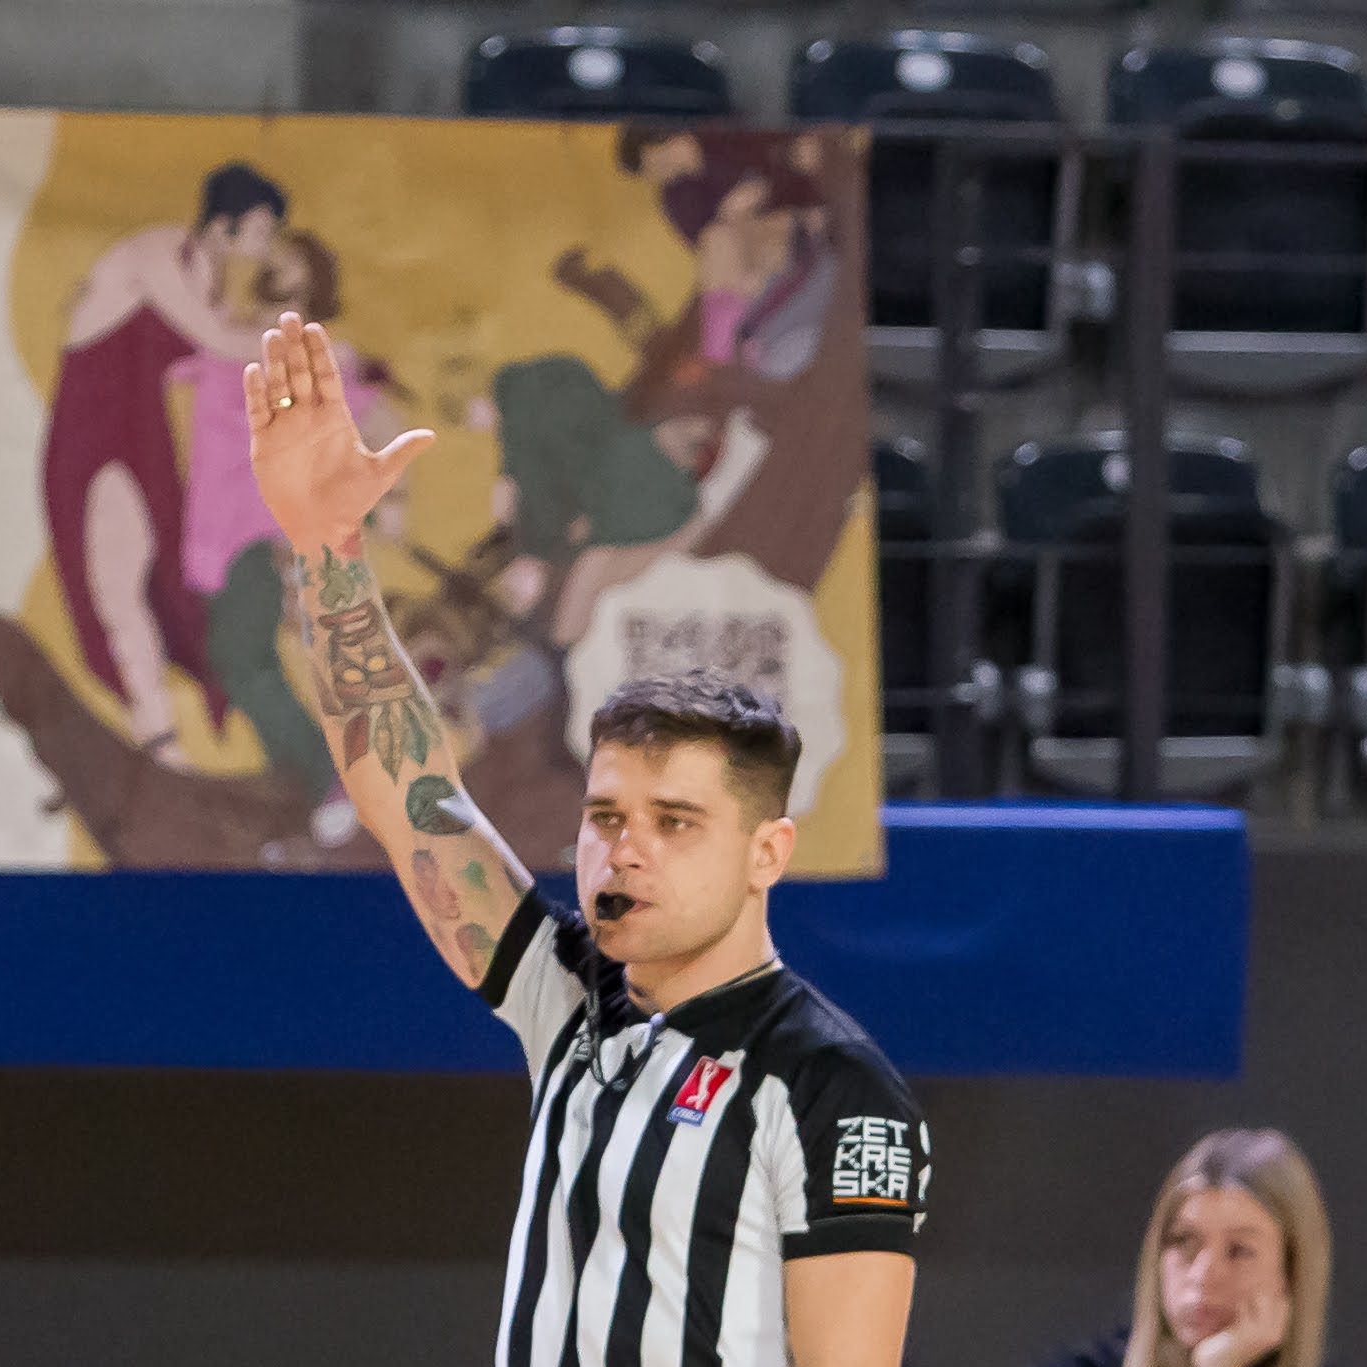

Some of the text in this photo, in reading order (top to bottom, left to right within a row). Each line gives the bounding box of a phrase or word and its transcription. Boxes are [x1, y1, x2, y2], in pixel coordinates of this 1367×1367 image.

[836, 1116, 908, 1146] ZET
[834, 1143, 911, 1174] KRE
[832, 1169, 909, 1200] SKA
